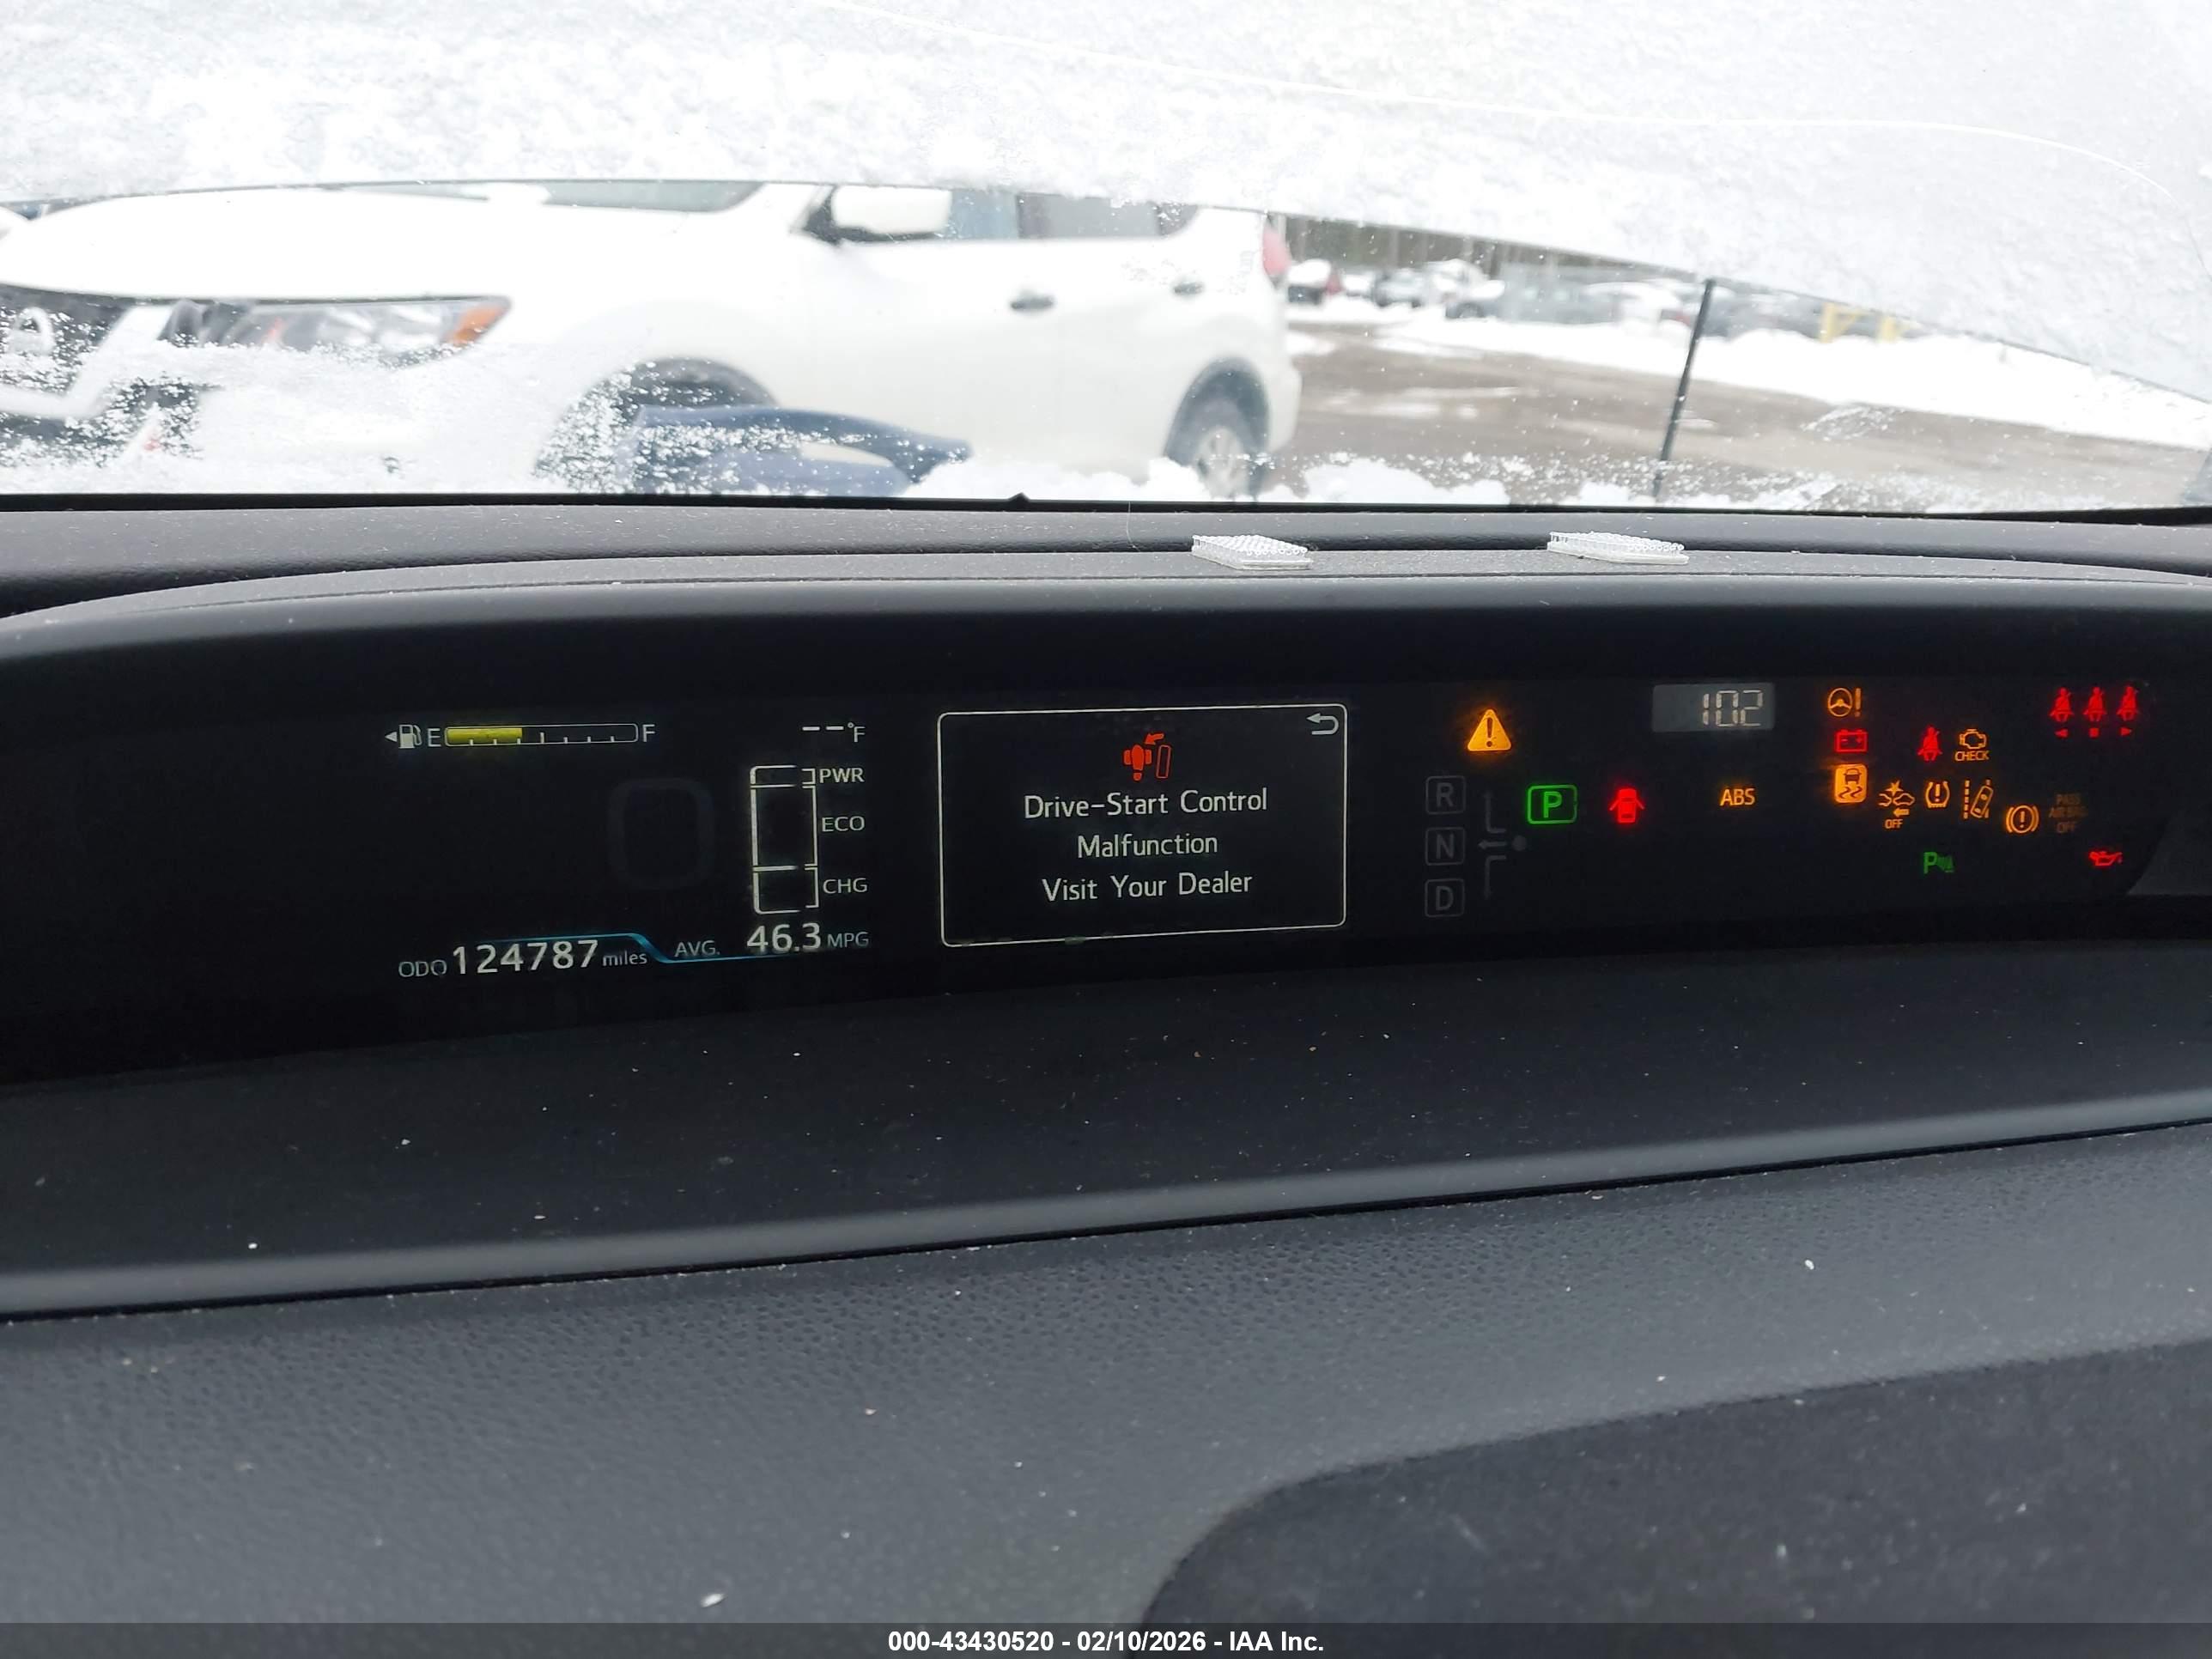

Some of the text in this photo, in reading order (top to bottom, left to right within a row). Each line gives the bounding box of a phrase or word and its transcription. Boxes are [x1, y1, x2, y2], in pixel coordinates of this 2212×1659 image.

[1702, 690, 1764, 727] 102
[427, 728, 441, 747] E
[642, 724, 655, 742] F
[1954, 750, 1990, 762] CHECK
[819, 767, 865, 783] PWR
[1024, 787, 1267, 818] Drive-Start Control
[1436, 782, 1454, 806] R
[1544, 791, 1562, 818] P
[1720, 788, 1756, 806] ABS
[821, 816, 866, 833] ECO
[1885, 818, 1903, 830] OFF
[1078, 834, 1218, 859] Malfunction
[1436, 835, 1455, 860] N
[823, 878, 868, 895] CHG
[1042, 871, 1252, 902] Visit Your Dealer
[1435, 886, 1454, 910] D
[675, 922, 869, 957] AVG. 46.3 MPG
[398, 940, 647, 978] ODO 124787 miles
